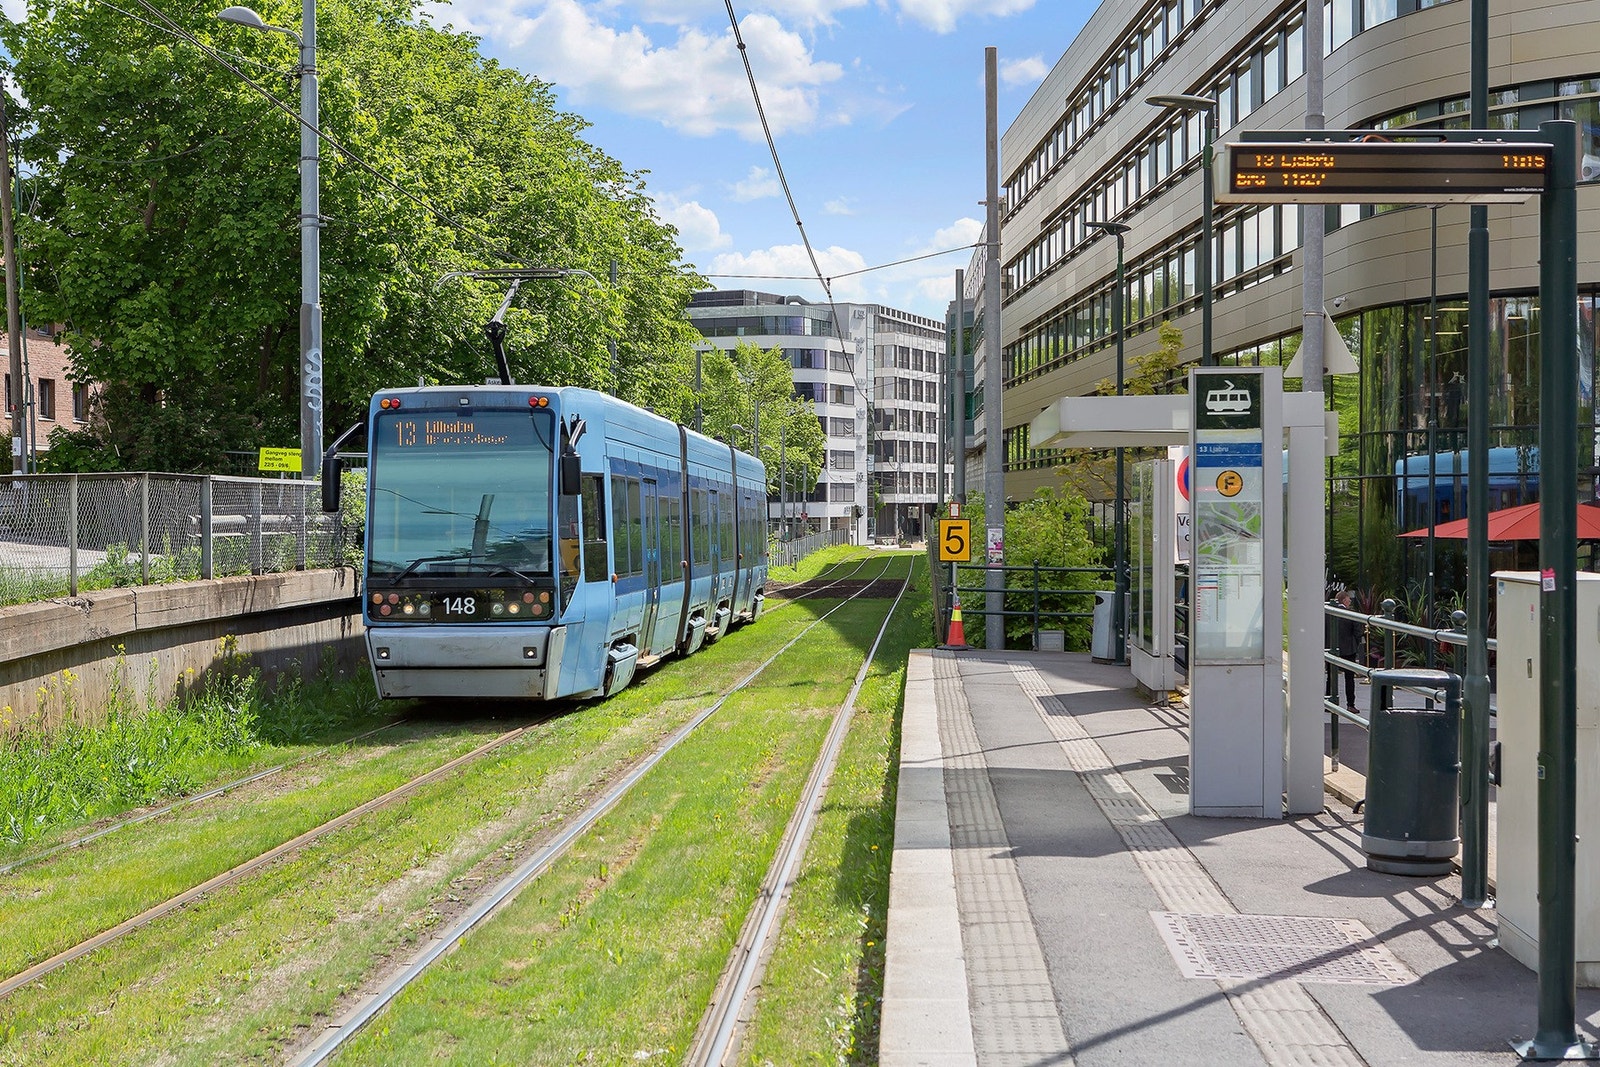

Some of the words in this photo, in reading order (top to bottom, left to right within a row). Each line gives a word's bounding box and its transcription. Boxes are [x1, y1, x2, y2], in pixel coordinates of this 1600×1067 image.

[395, 421, 416, 446] 13
[1209, 445, 1229, 454] Ljabru
[1224, 475, 1235, 490] F
[945, 525, 965, 555] 5
[442, 597, 476, 615] 148
